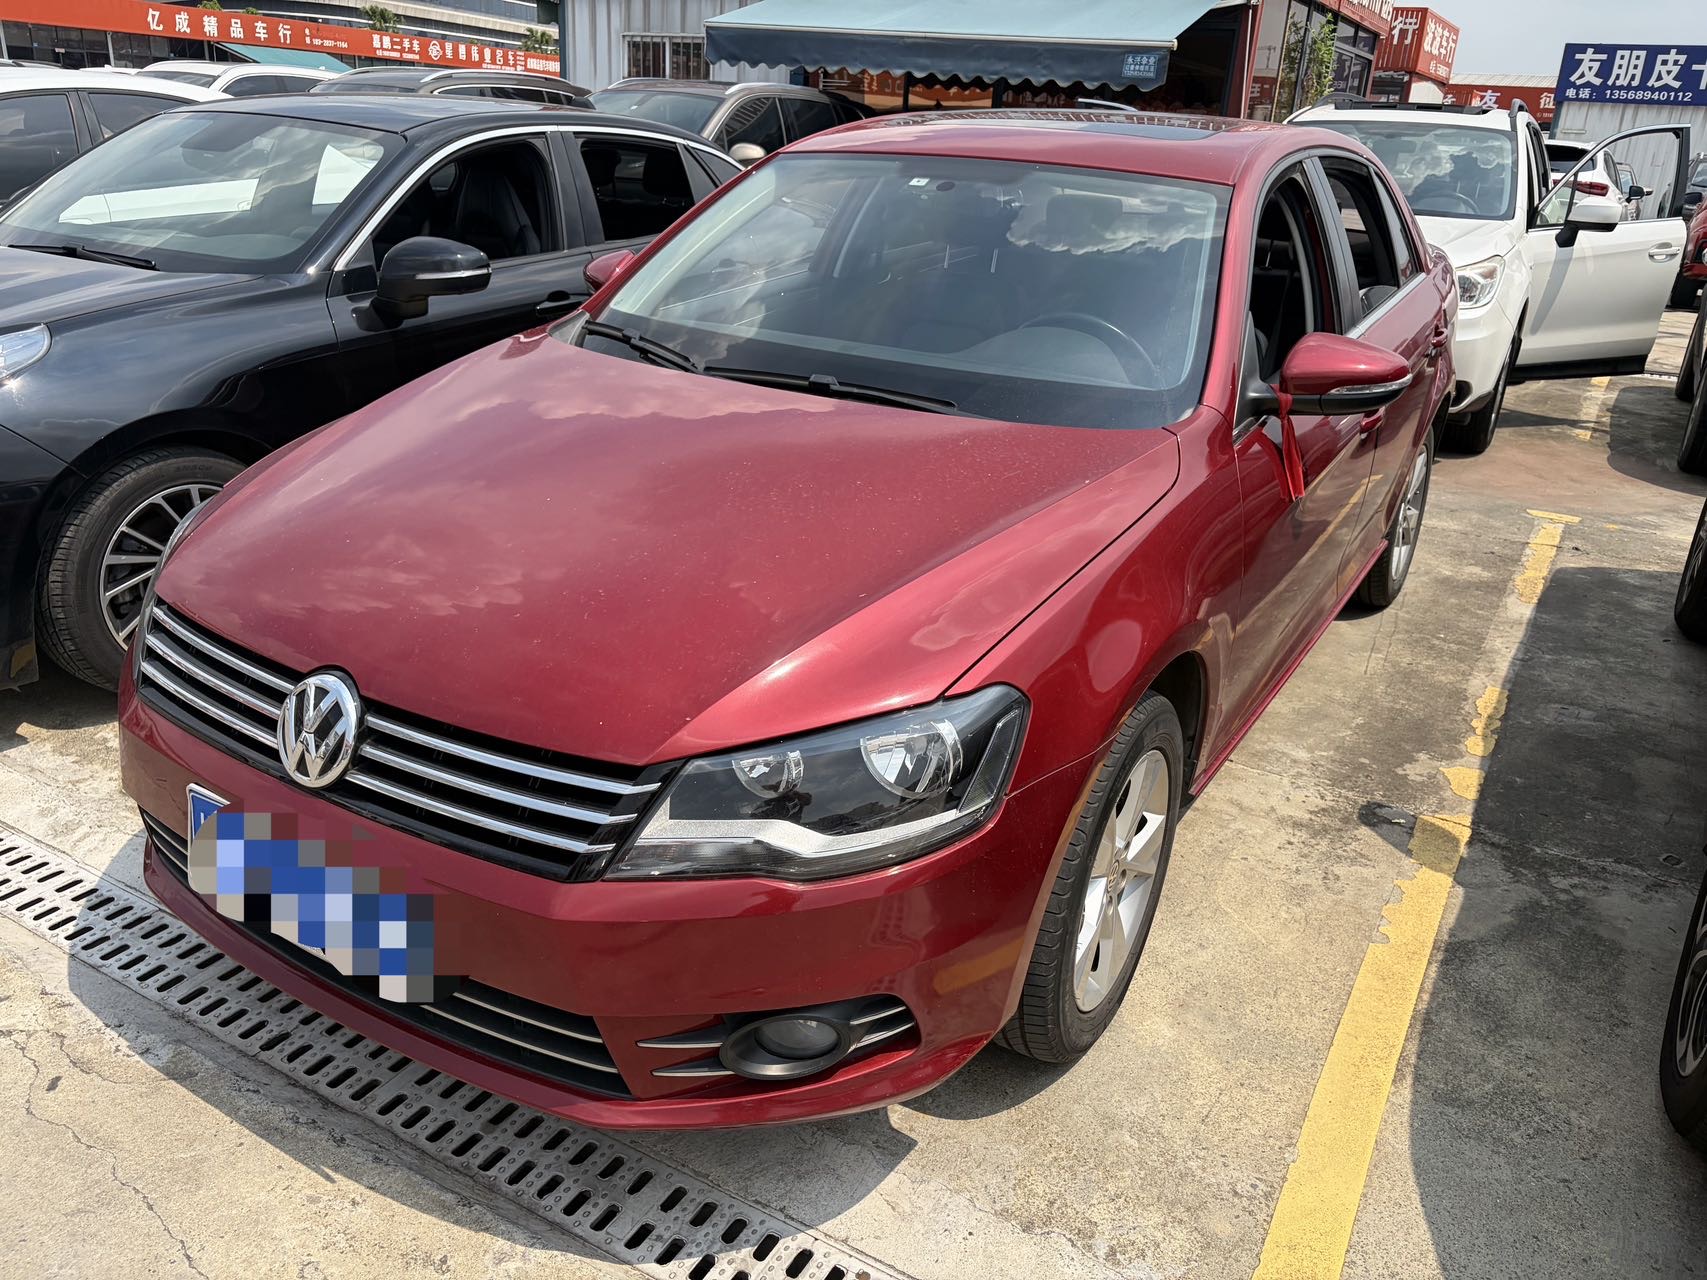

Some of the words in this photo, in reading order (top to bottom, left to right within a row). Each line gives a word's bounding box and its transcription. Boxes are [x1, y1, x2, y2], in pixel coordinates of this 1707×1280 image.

[147, 8, 292, 44] 亿成精品车行
[1604, 89, 1694, 101] 13568940112
